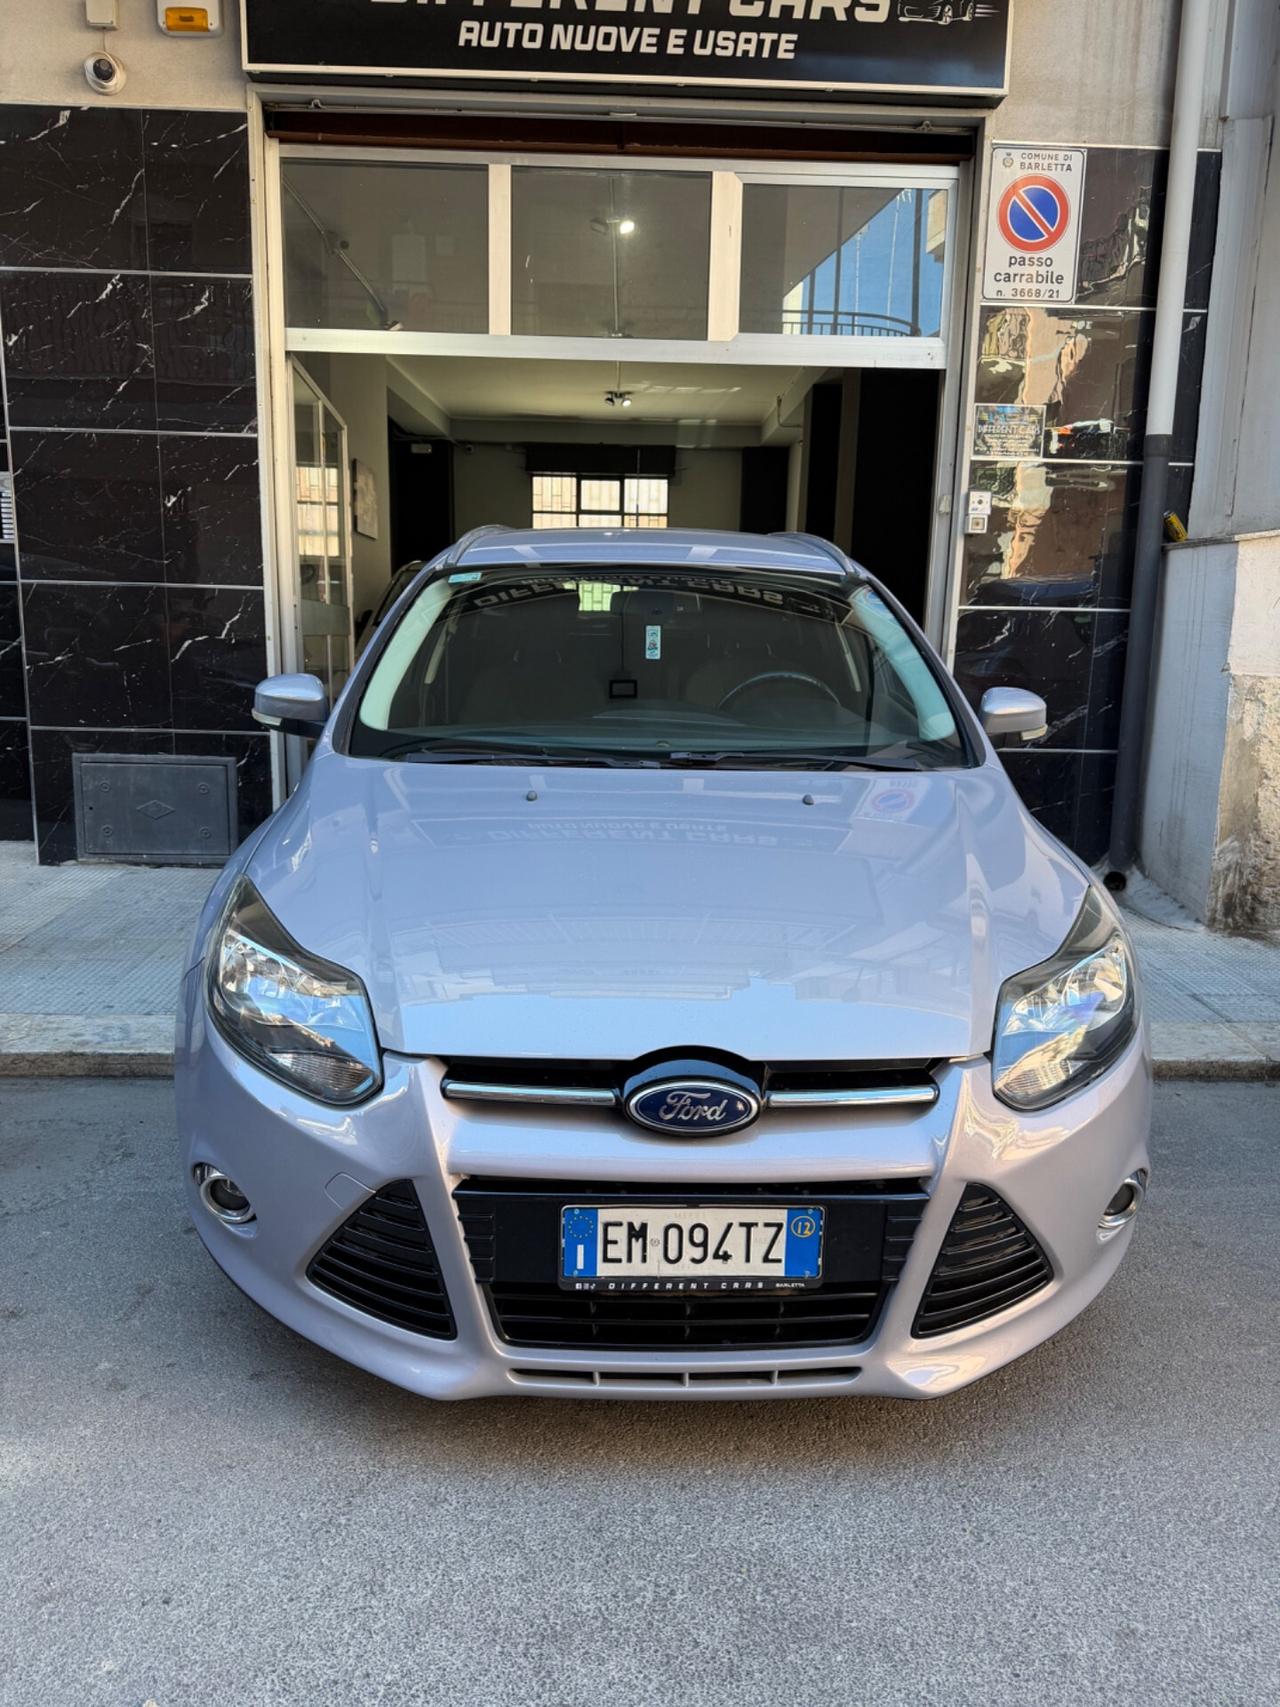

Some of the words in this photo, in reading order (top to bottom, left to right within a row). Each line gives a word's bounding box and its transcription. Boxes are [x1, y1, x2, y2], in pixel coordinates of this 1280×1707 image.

[458, 20, 544, 49] AUTO
[550, 24, 661, 54] NUOVE
[666, 28, 688, 55] E
[693, 30, 798, 60] USATE
[1020, 152, 1060, 161] COMUNE
[1063, 153, 1073, 162] DI
[1019, 161, 1073, 172] BARLETTA
[1008, 256, 1053, 268] passo
[993, 271, 1065, 285] carrabile
[1011, 288, 1060, 299] 3668/21
[658, 1091, 728, 1121] Ford
[795, 1222, 812, 1236] 12
[601, 1221, 649, 1264] EM
[662, 1222, 784, 1265] 094TZ
[608, 1282, 710, 1290] DIFFERENT
[720, 1282, 765, 1290] CARS
